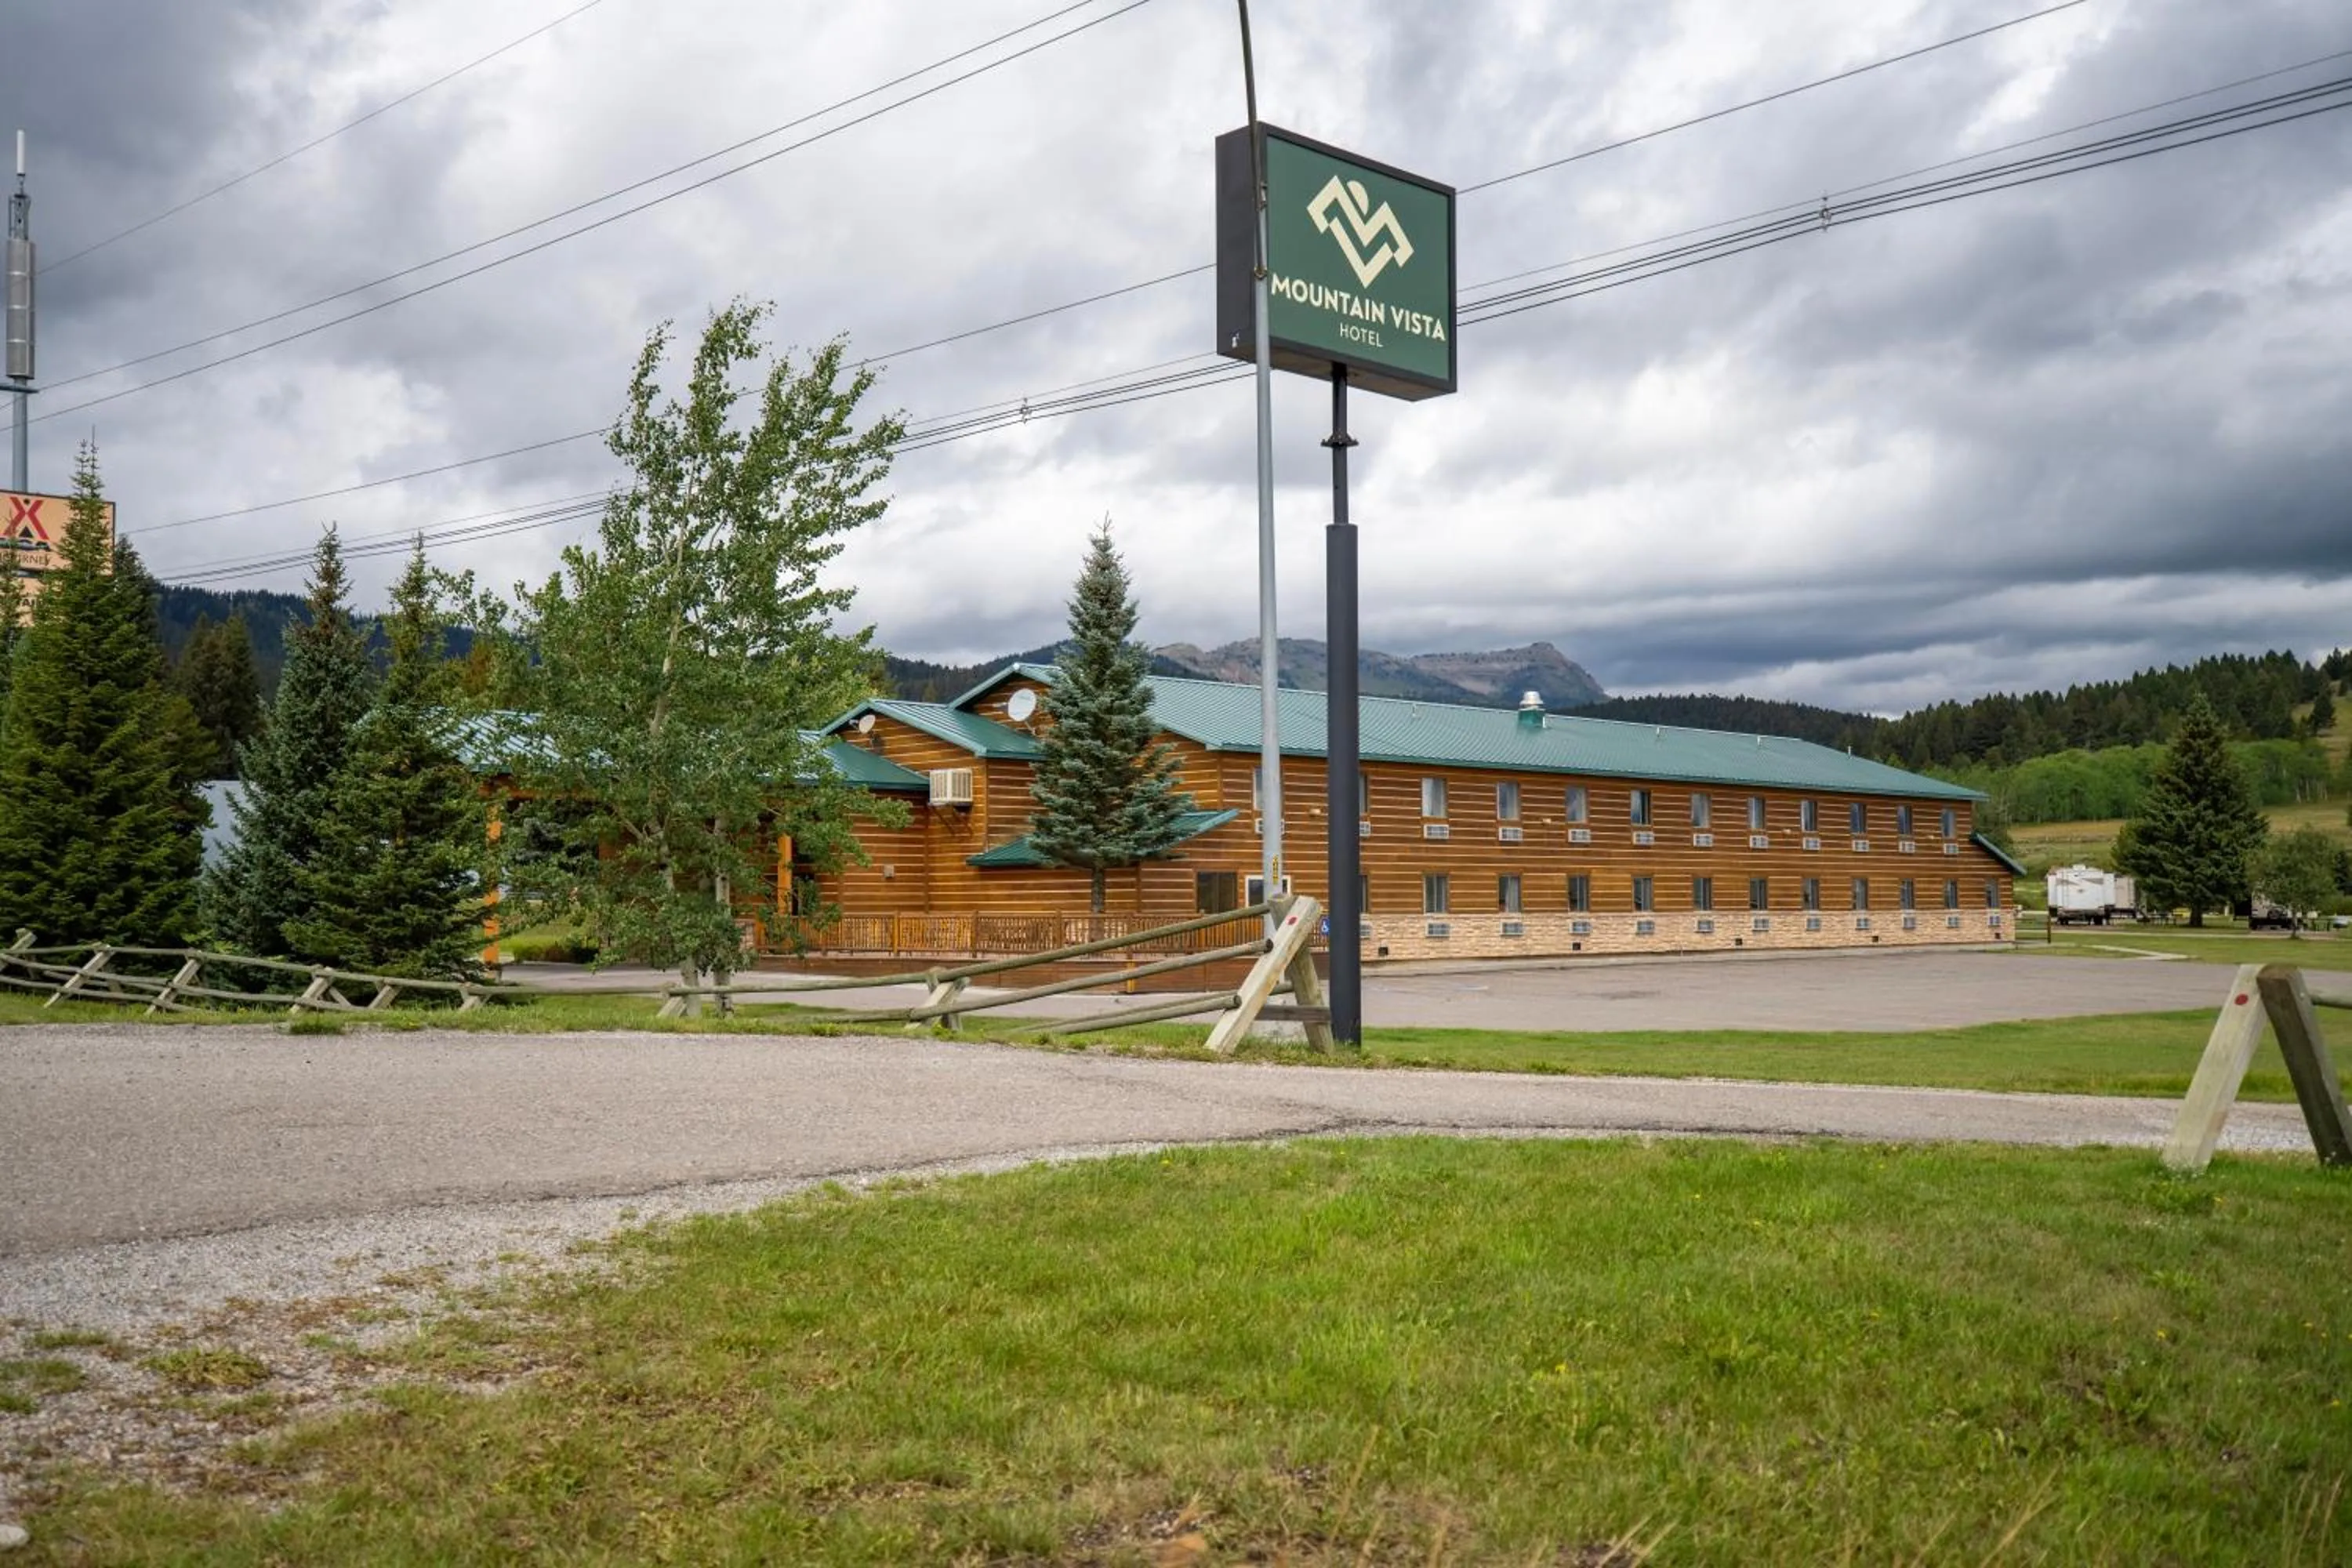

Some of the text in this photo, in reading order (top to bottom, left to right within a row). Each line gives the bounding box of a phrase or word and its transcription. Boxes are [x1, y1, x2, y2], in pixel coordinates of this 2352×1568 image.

[1271, 273, 1446, 341] MOUNTAIN VISTA
[1340, 322, 1384, 347] HOTEL
